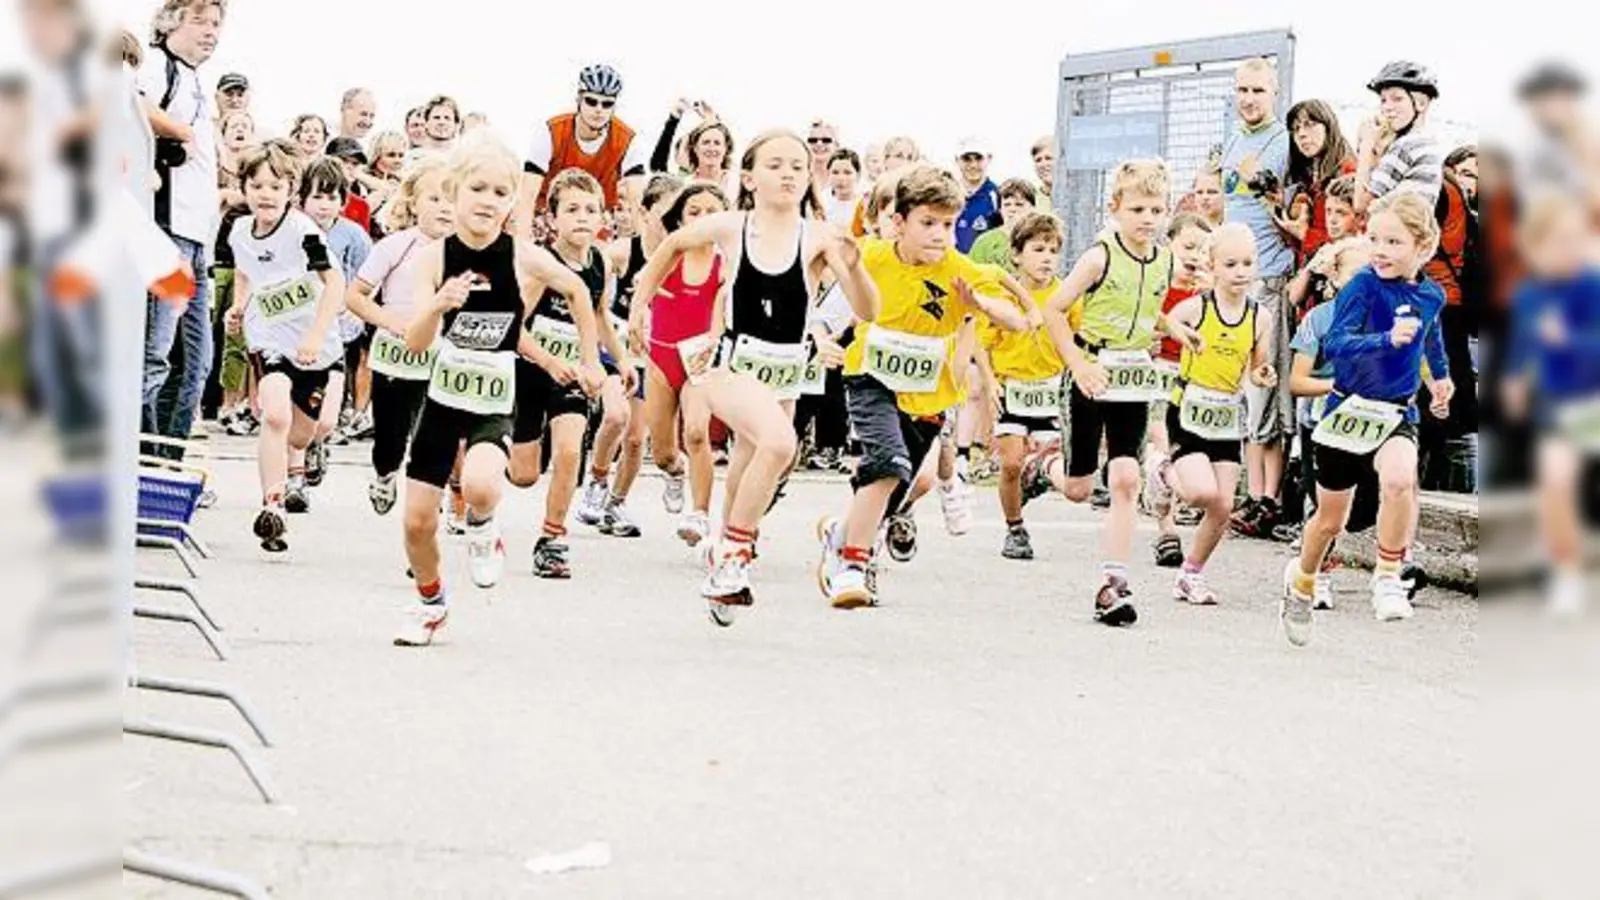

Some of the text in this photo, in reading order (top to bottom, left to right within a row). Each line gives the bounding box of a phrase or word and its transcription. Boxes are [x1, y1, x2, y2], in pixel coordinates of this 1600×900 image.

[262, 285, 308, 313] 1014
[877, 350, 932, 378] 1009
[442, 369, 504, 397] 1010
[1332, 413, 1384, 440] 1011
